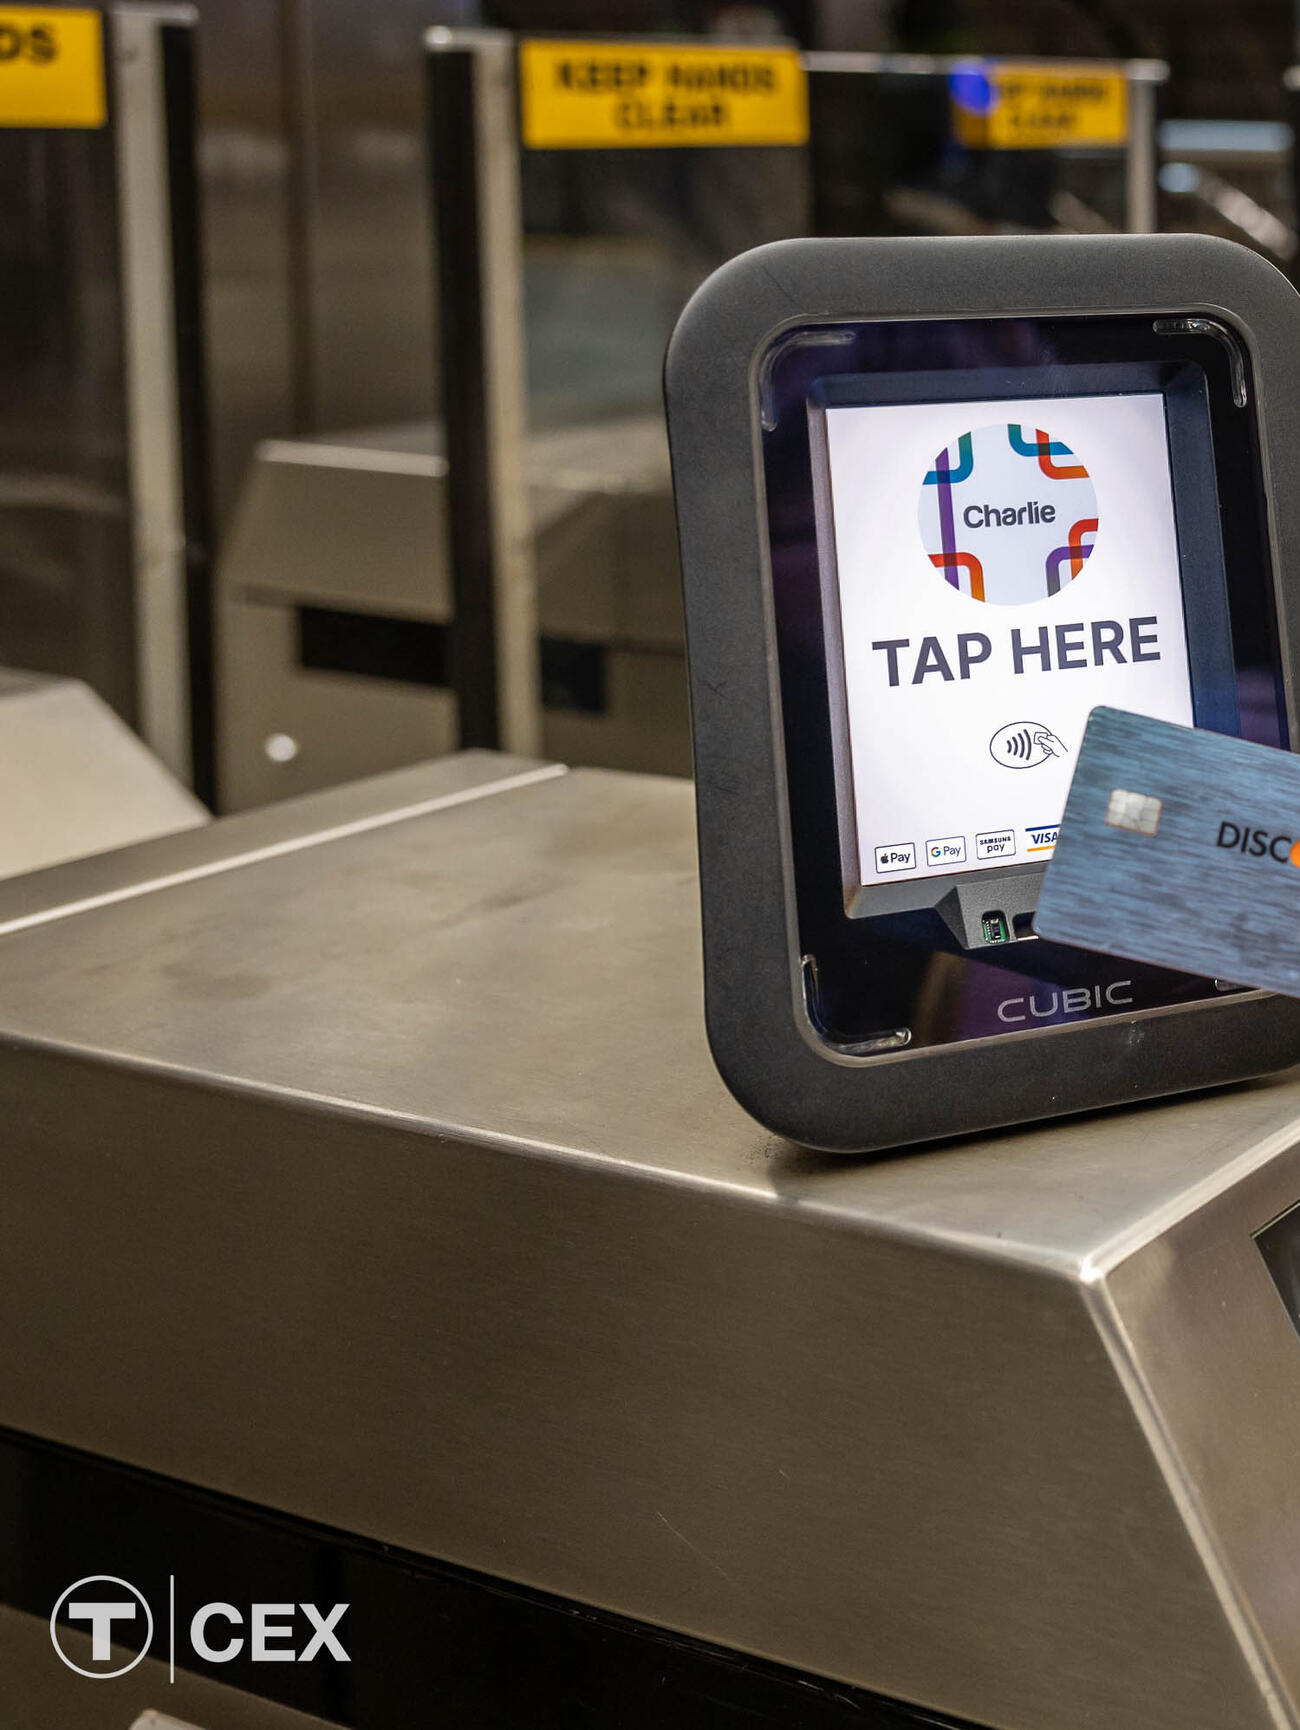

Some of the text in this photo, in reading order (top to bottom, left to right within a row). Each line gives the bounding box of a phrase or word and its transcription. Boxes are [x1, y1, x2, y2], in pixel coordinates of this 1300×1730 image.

[557, 60, 776, 92] KEEP HANDS
[614, 101, 729, 130] CLEAR
[963, 501, 1056, 529] Charlie
[872, 616, 1161, 688] TAP HERE
[890, 852, 911, 864] Pay
[943, 846, 961, 857] Pay
[987, 843, 1005, 854] pay
[997, 980, 1134, 1023] CUBIC
